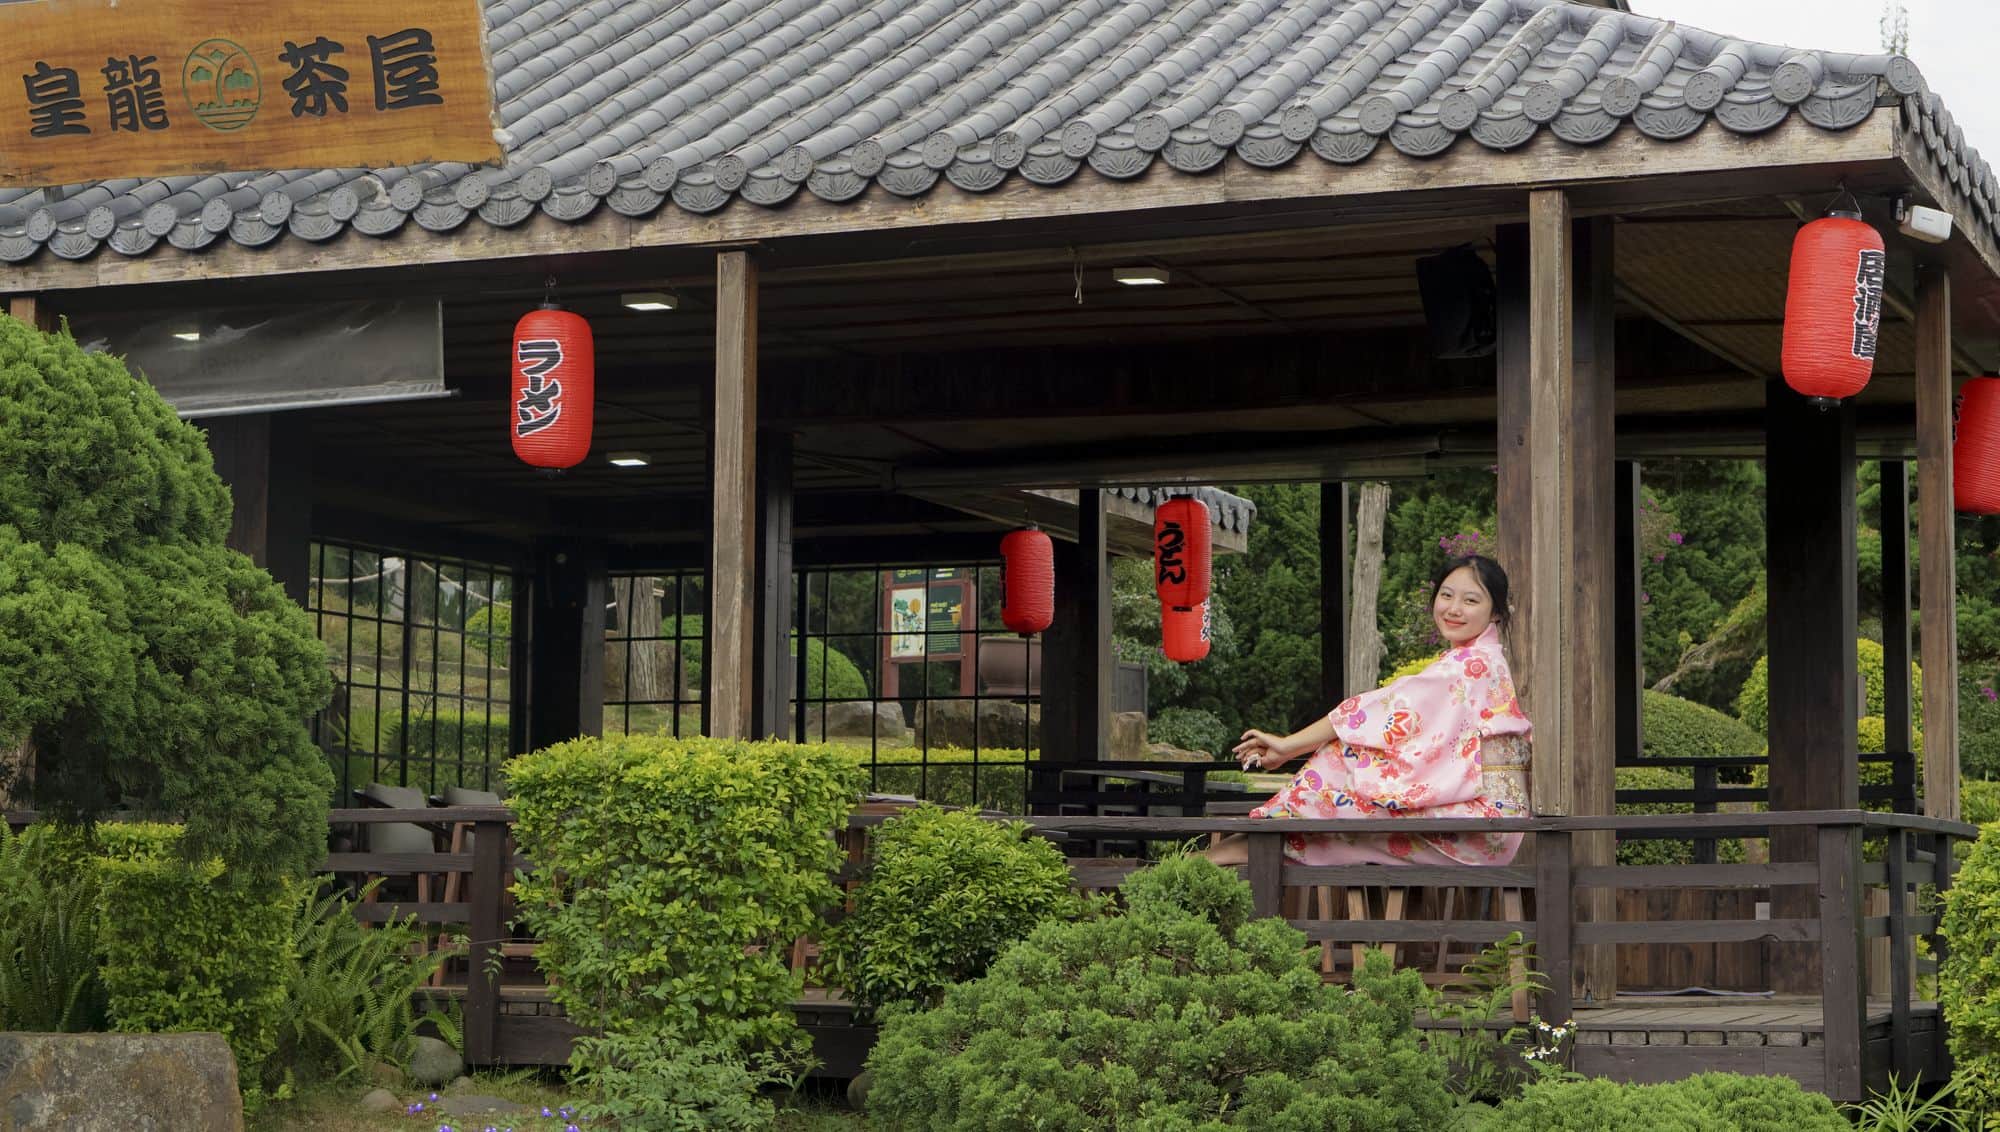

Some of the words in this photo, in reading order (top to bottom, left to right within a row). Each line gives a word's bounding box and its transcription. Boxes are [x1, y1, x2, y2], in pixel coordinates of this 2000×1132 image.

[22, 54, 170, 138] 皇龍
[280, 28, 444, 118] 茶屋
[516, 339, 563, 437] ラーメン
[1157, 521, 1186, 585] うどん
